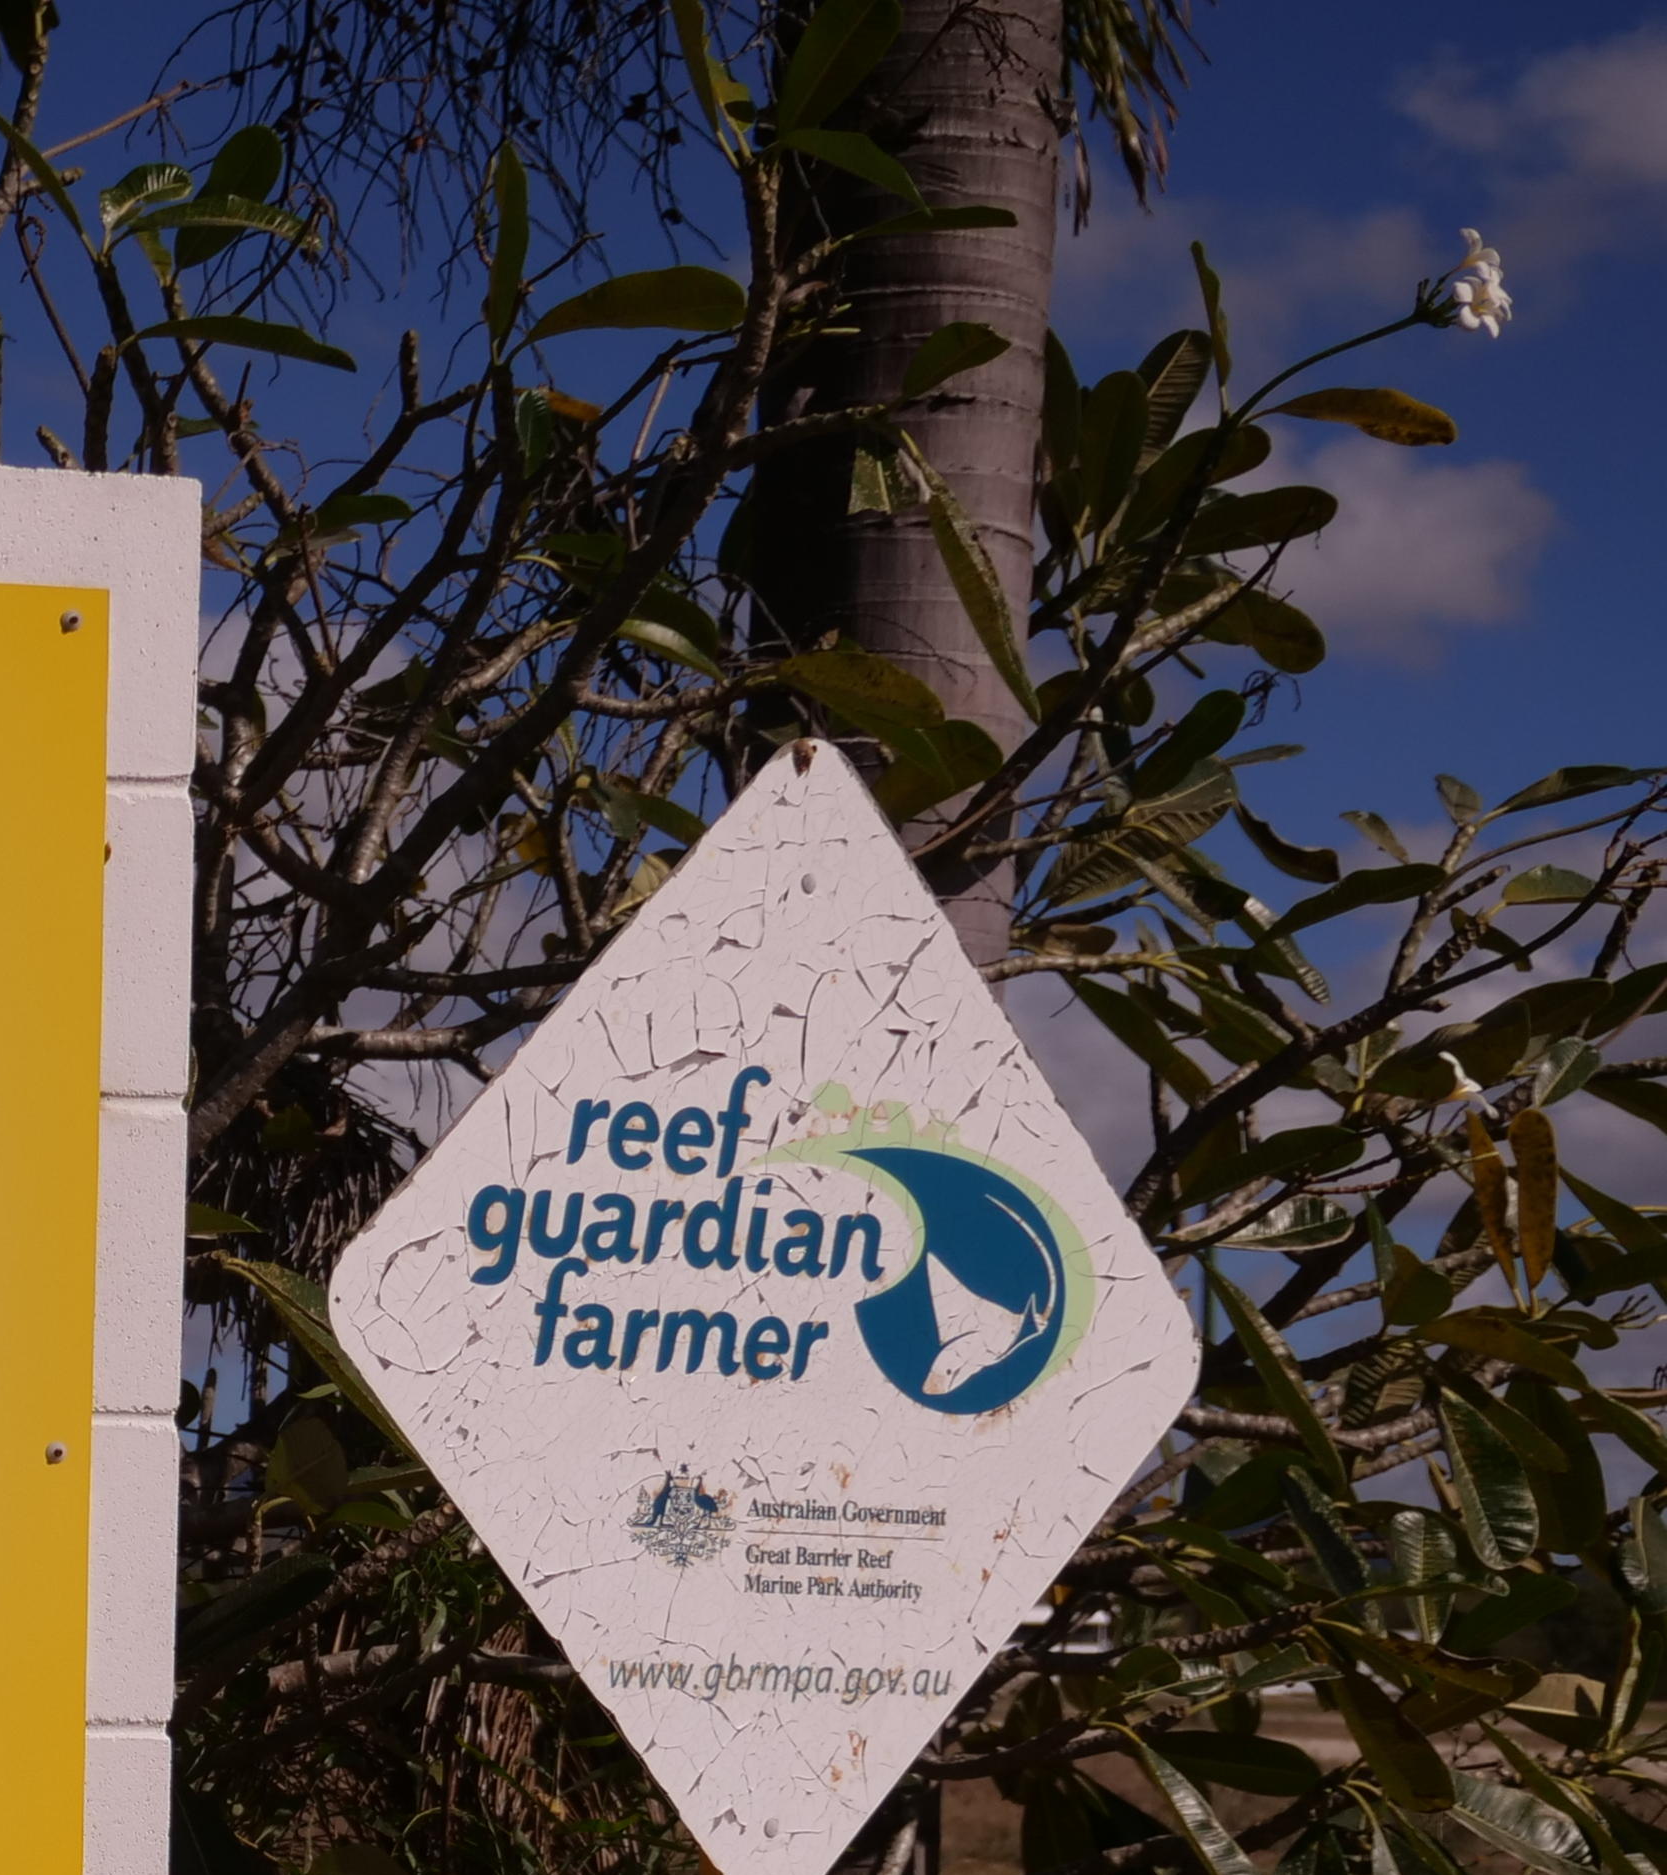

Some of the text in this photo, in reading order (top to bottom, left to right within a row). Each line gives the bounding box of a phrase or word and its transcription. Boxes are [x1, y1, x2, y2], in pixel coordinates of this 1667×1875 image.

[567, 1065, 771, 1178] reef
[468, 1178, 884, 1284] guardian
[534, 1257, 828, 1380] farmer
[747, 1498, 947, 1527] Australian Government
[745, 1544, 893, 1569] Great Barrier Reef
[744, 1574, 923, 1603] Marine Park Authority
[608, 1652, 952, 1704] www.gbrmpa.gov.au
